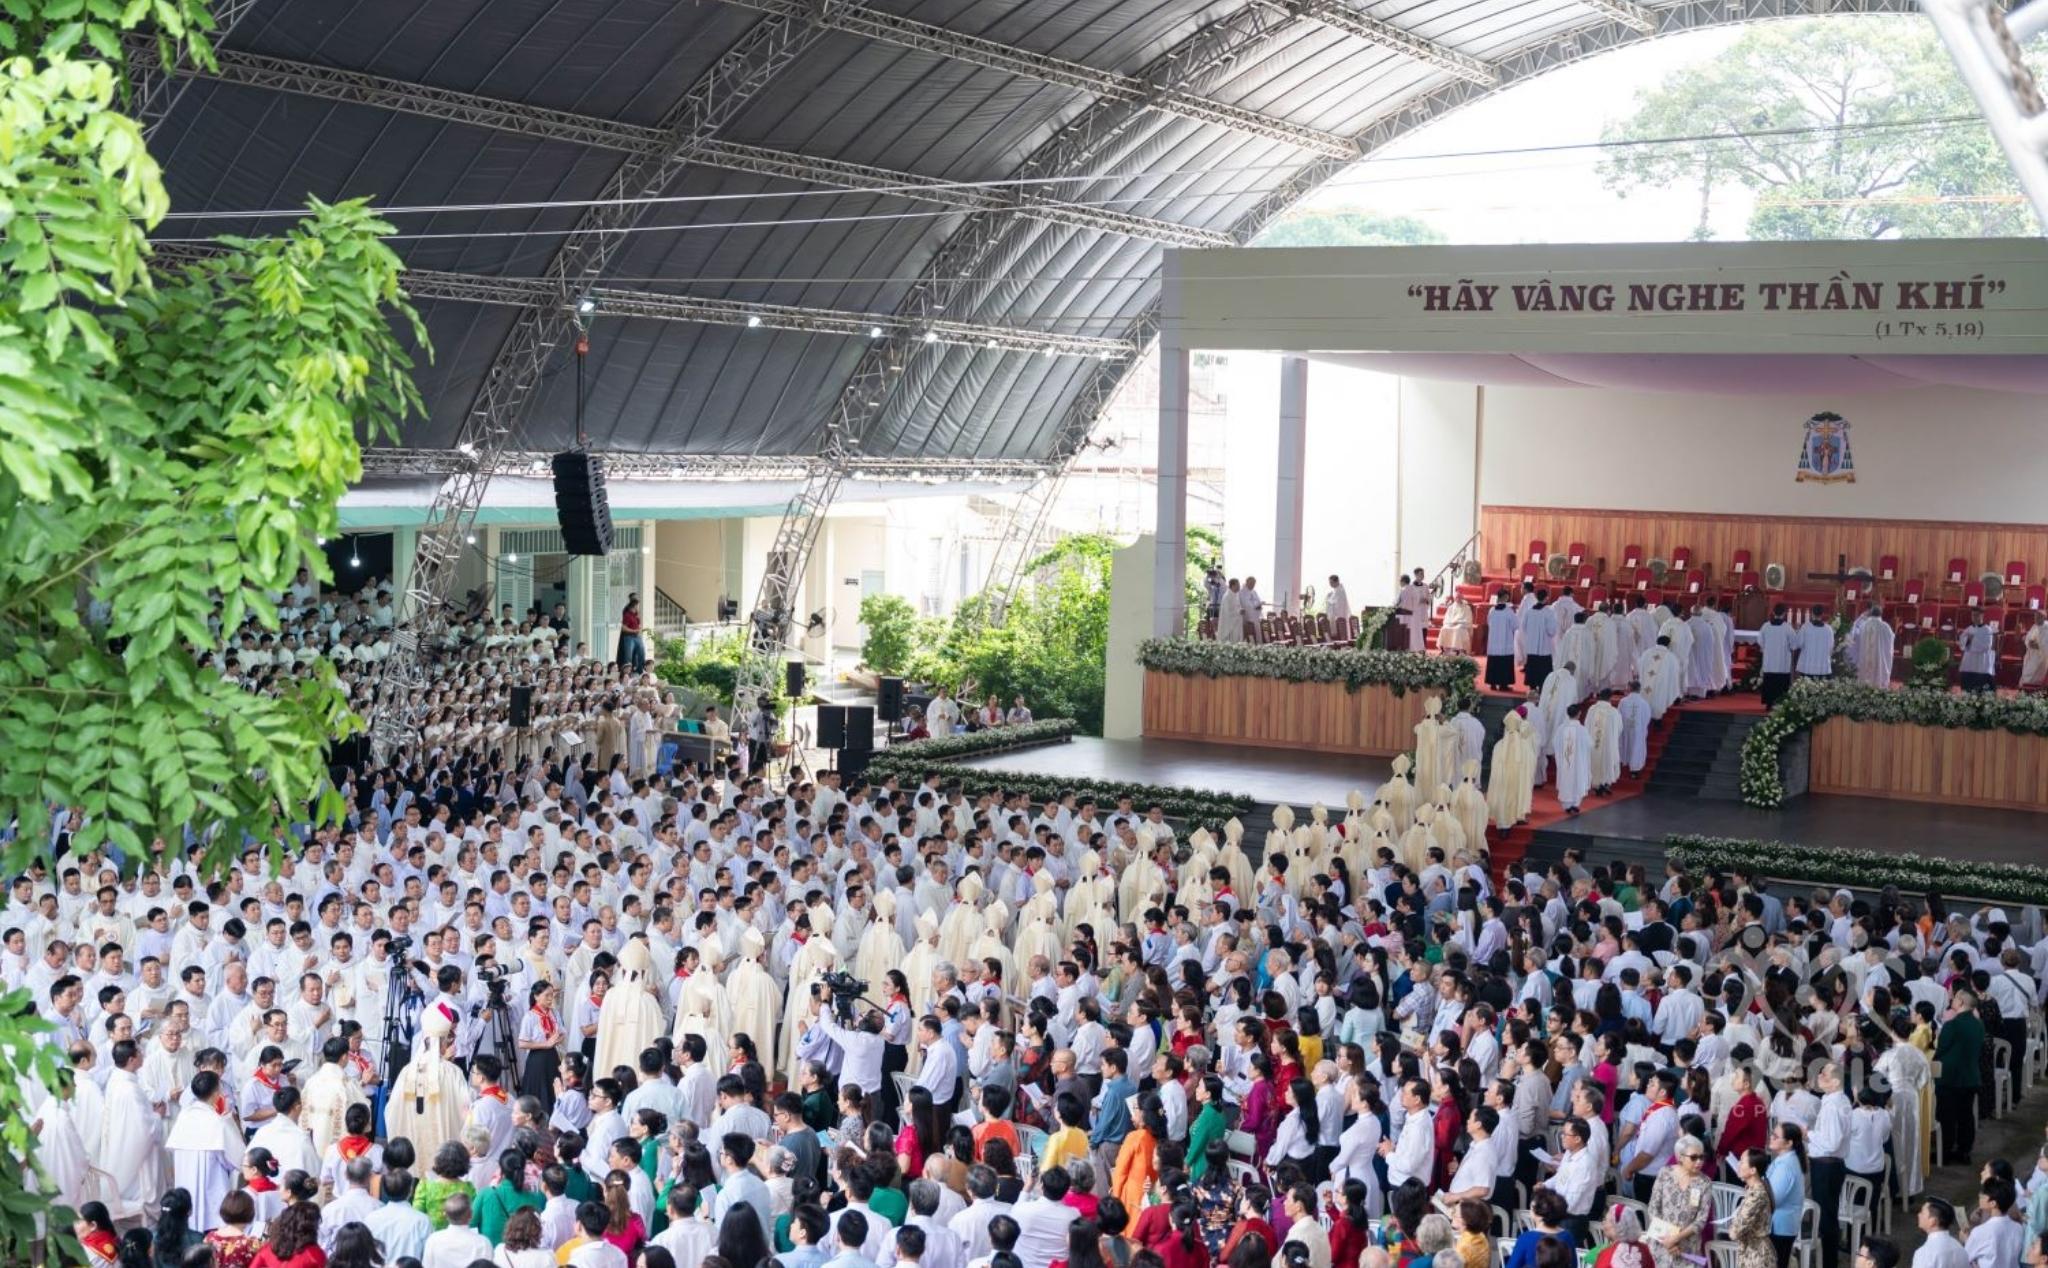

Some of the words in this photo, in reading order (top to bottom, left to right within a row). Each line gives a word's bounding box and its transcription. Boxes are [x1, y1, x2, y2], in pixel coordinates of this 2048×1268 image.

[1407, 279, 1499, 311] “HÃY
[1511, 279, 1615, 311] VÂNG
[1627, 283, 1745, 311] NGHE
[1759, 270, 1884, 310] THẦN
[1896, 274, 2006, 310] KHÍ”
[1875, 320, 1891, 338] (1
[1900, 321, 1928, 337] Tx
[1935, 320, 1984, 341] 5,19)
